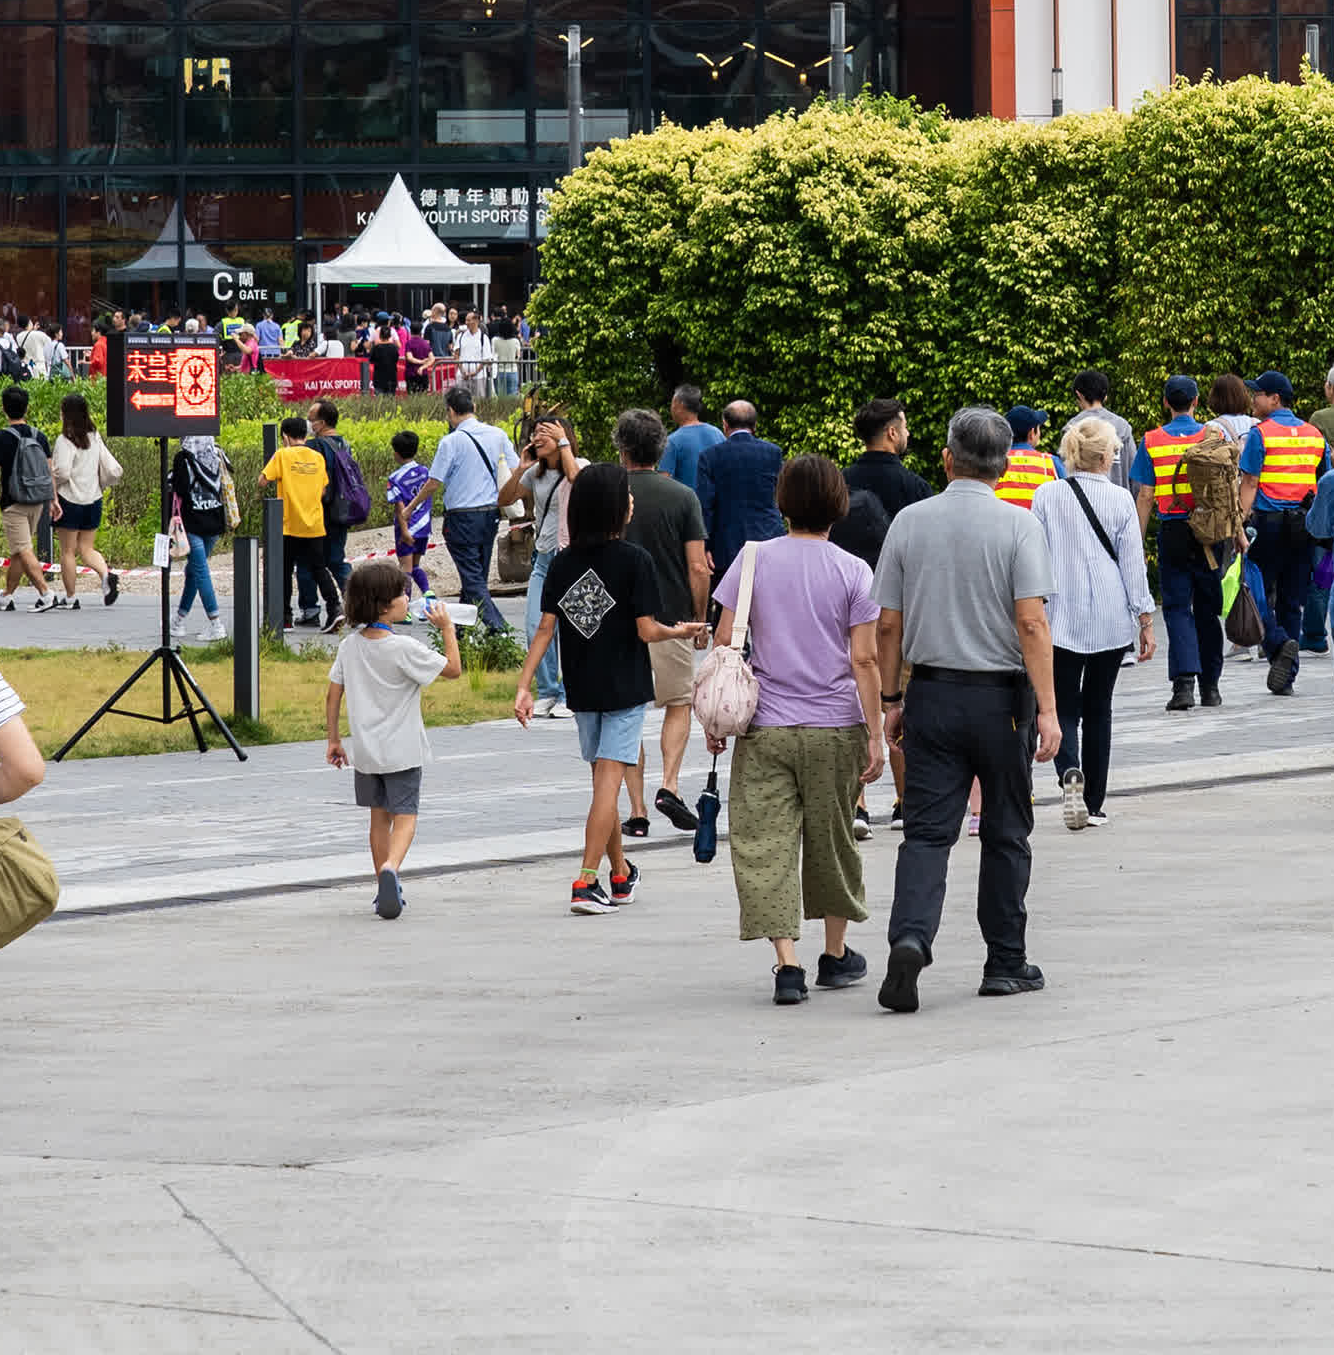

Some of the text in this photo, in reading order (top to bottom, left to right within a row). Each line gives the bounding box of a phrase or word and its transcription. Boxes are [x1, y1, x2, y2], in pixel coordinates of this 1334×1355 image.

[408, 187, 553, 207] 德青年運動場
[471, 209, 529, 224] SPORTS
[213, 272, 234, 301] C
[238, 289, 268, 300] GATE
[304, 381, 318, 391] KAI
[319, 380, 334, 390] TAK
